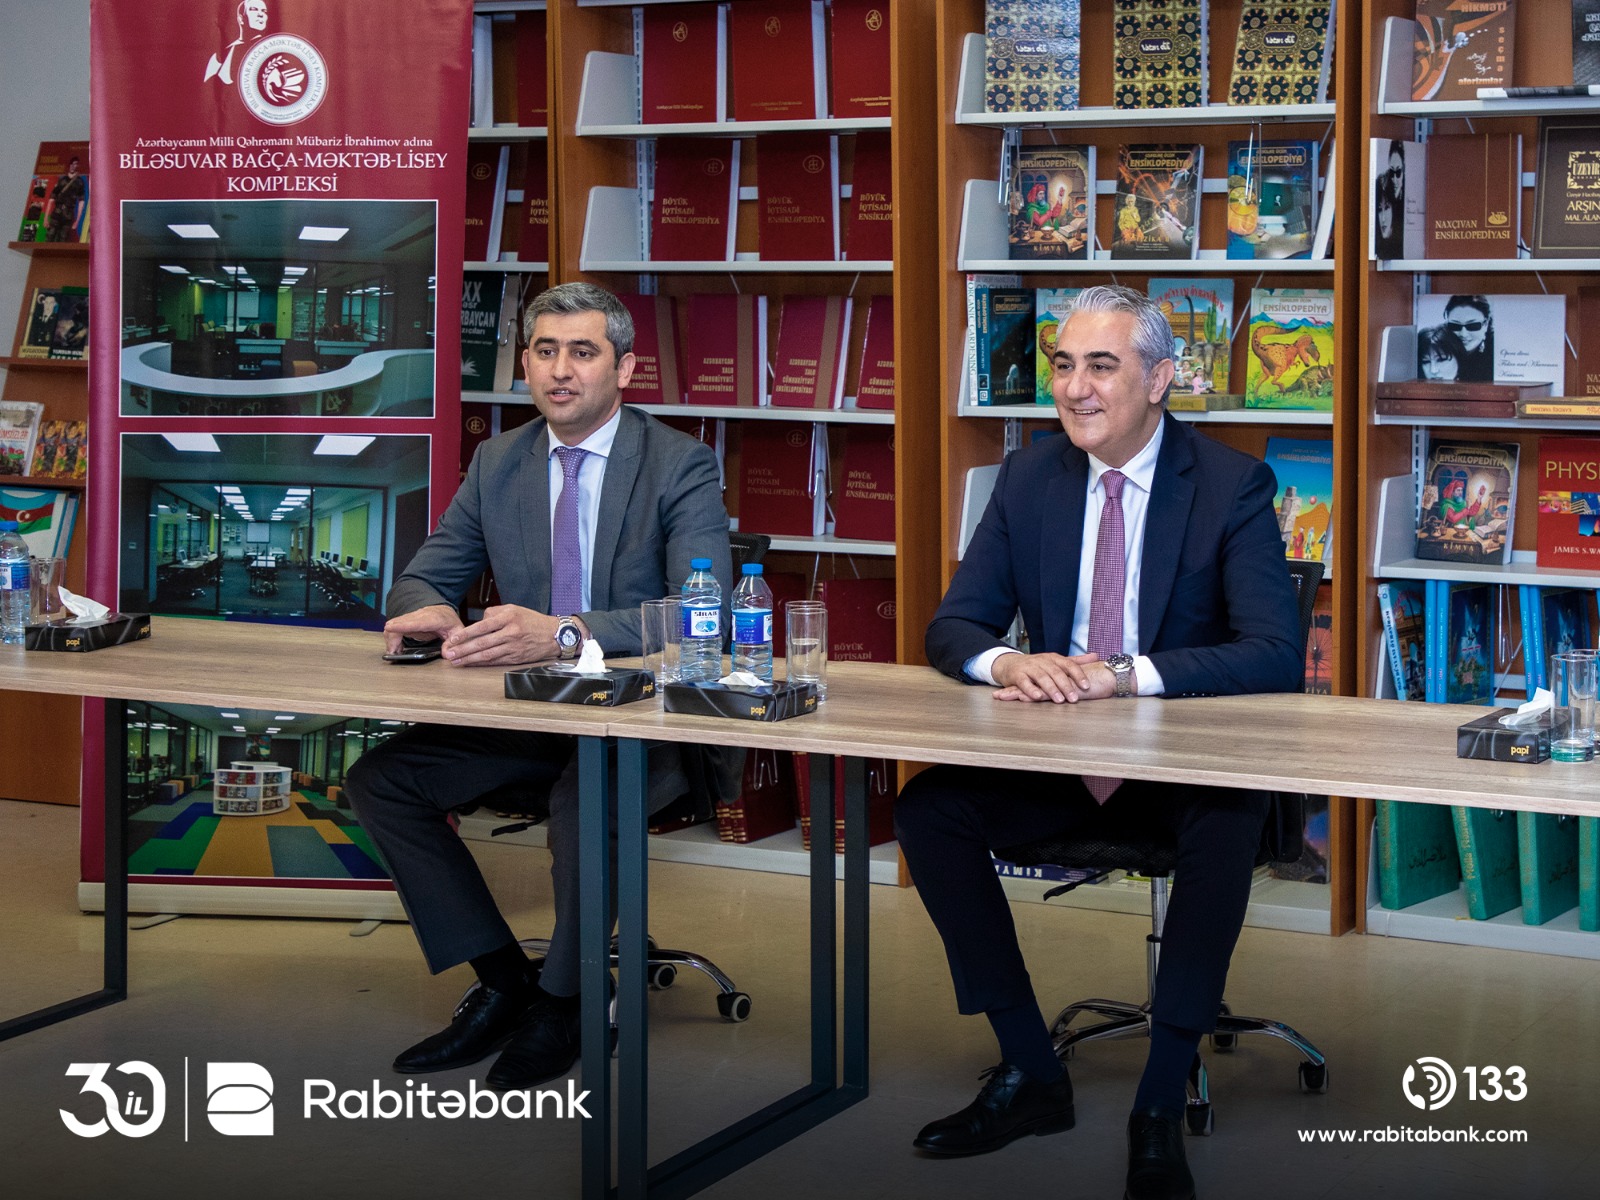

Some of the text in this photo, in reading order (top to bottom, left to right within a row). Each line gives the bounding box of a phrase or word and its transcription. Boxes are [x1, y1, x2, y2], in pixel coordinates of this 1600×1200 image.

[136, 134, 433, 150] Azərbaycanın Milli Qəhrəmanı Mübariz İbrahimov adına
[119, 149, 448, 171] BİLƏSUVAR BAĞÇA-MƏKTƏB-LİSEY
[227, 173, 338, 193] KOMPLEKSİ
[662, 197, 688, 205] BÖYÜK
[859, 193, 886, 202] BÖYÜK
[662, 206, 695, 215] İQTİSADİ
[661, 215, 720, 225] ENSİKLOPEDİYA
[1435, 220, 1478, 229] NAXÇIVAN
[1435, 230, 1510, 240] ENSİKLOPEDİYASI
[462, 281, 482, 302] XX
[1263, 303, 1328, 313] ENSİKLOPEDİYA
[967, 281, 977, 377] ORGANIC GARDENING
[848, 470, 872, 480] BÖYÜK
[1554, 545, 1580, 554] JAMES
[66, 638, 80, 647] papi
[834, 642, 864, 651] BÖYÜK
[643, 682, 653, 693] papi
[593, 691, 607, 700] papi
[805, 696, 815, 707] papi
[751, 705, 765, 715] papi
[1511, 745, 1530, 756] papi
